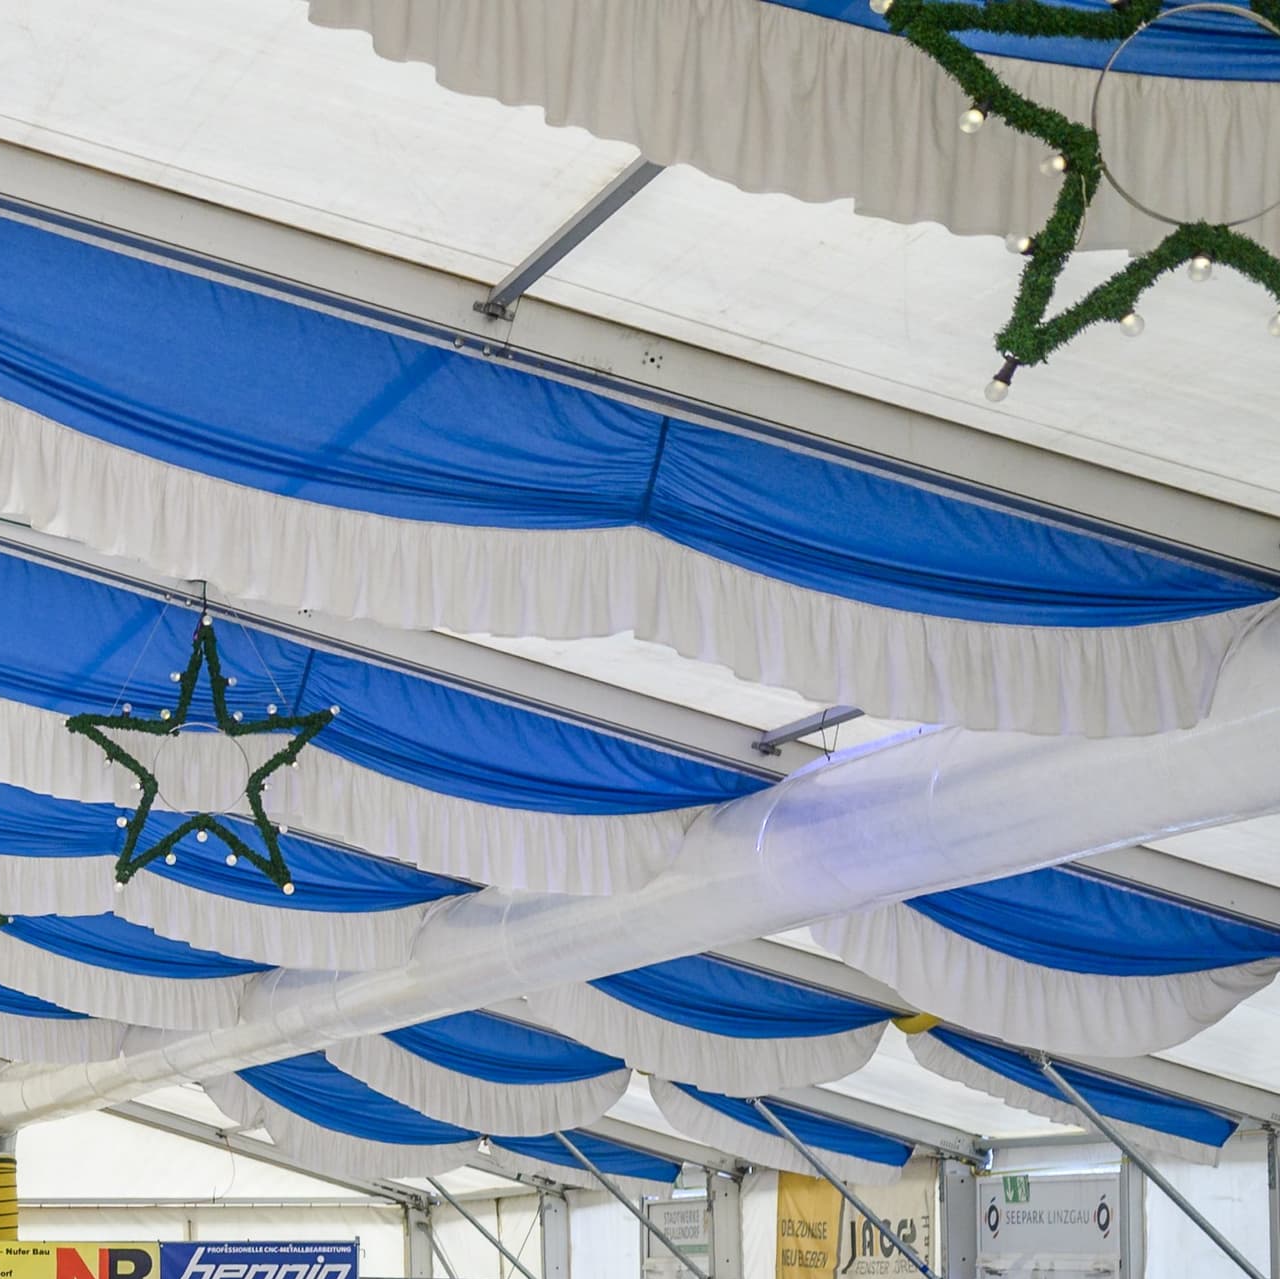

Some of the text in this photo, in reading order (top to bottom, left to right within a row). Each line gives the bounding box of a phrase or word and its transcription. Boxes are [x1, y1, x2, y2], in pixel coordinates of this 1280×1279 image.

[1005, 1209, 1090, 1225] SEEPARK LINZGAU
[5, 1248, 30, 1256] Nufer
[32, 1248, 51, 1256] Bau
[207, 1246, 263, 1254] PROFESSIONELLE
